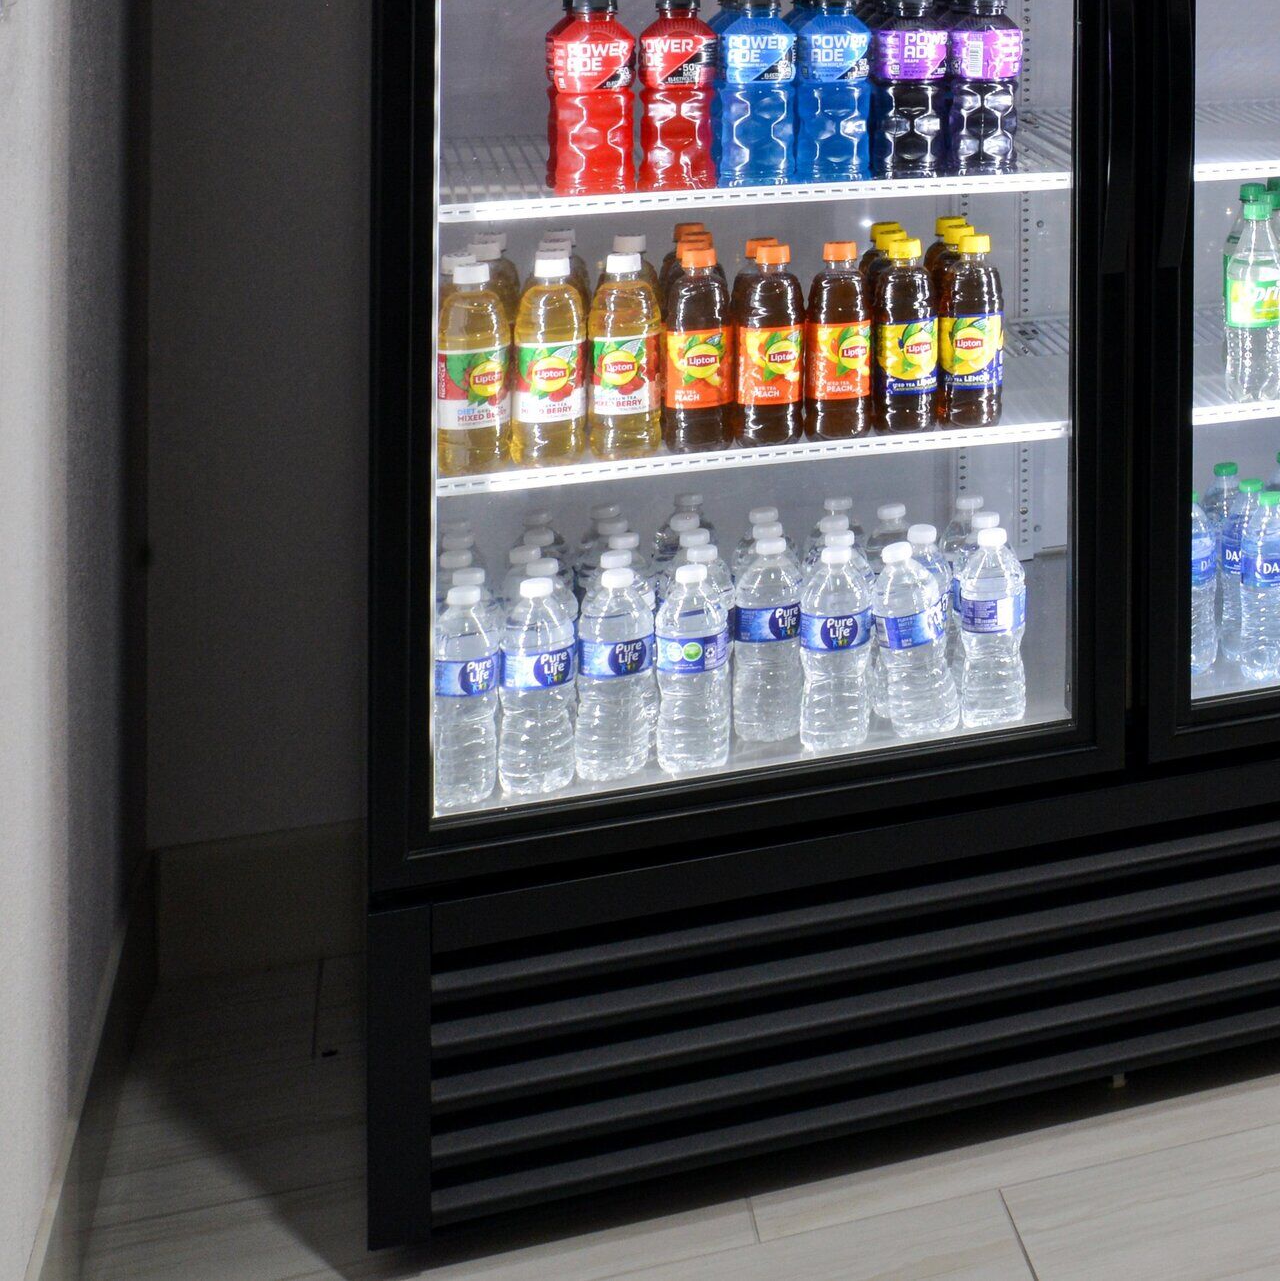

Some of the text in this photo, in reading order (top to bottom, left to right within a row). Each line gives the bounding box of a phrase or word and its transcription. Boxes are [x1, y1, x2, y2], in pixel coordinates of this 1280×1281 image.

[729, 35, 788, 49] POWER
[812, 35, 867, 48] POWER
[905, 32, 948, 45] POWE
[567, 42, 628, 57] POWER
[642, 39, 693, 52] OWER
[728, 49, 760, 62] ADE
[811, 49, 843, 62] ADE
[844, 347, 866, 357] Lipton
[909, 343, 930, 352] Lipton
[607, 363, 632, 371] Lipton
[689, 356, 715, 365] Lipton
[538, 370, 564, 378] Lipton
[964, 372, 989, 382] LEMON
[616, 399, 642, 407] BERRY
[547, 406, 572, 414] BERRY
[458, 414, 484, 422] MIXED
[775, 606, 798, 620] Pure
[778, 615, 797, 628] Life
[826, 617, 854, 630] Pure
[830, 626, 851, 640] Life
[615, 640, 642, 656] Pure
[540, 651, 568, 665] Pure
[618, 650, 640, 664] Life
[467, 659, 492, 672] Pure
[543, 663, 565, 676] Life
[470, 669, 490, 684] Life
